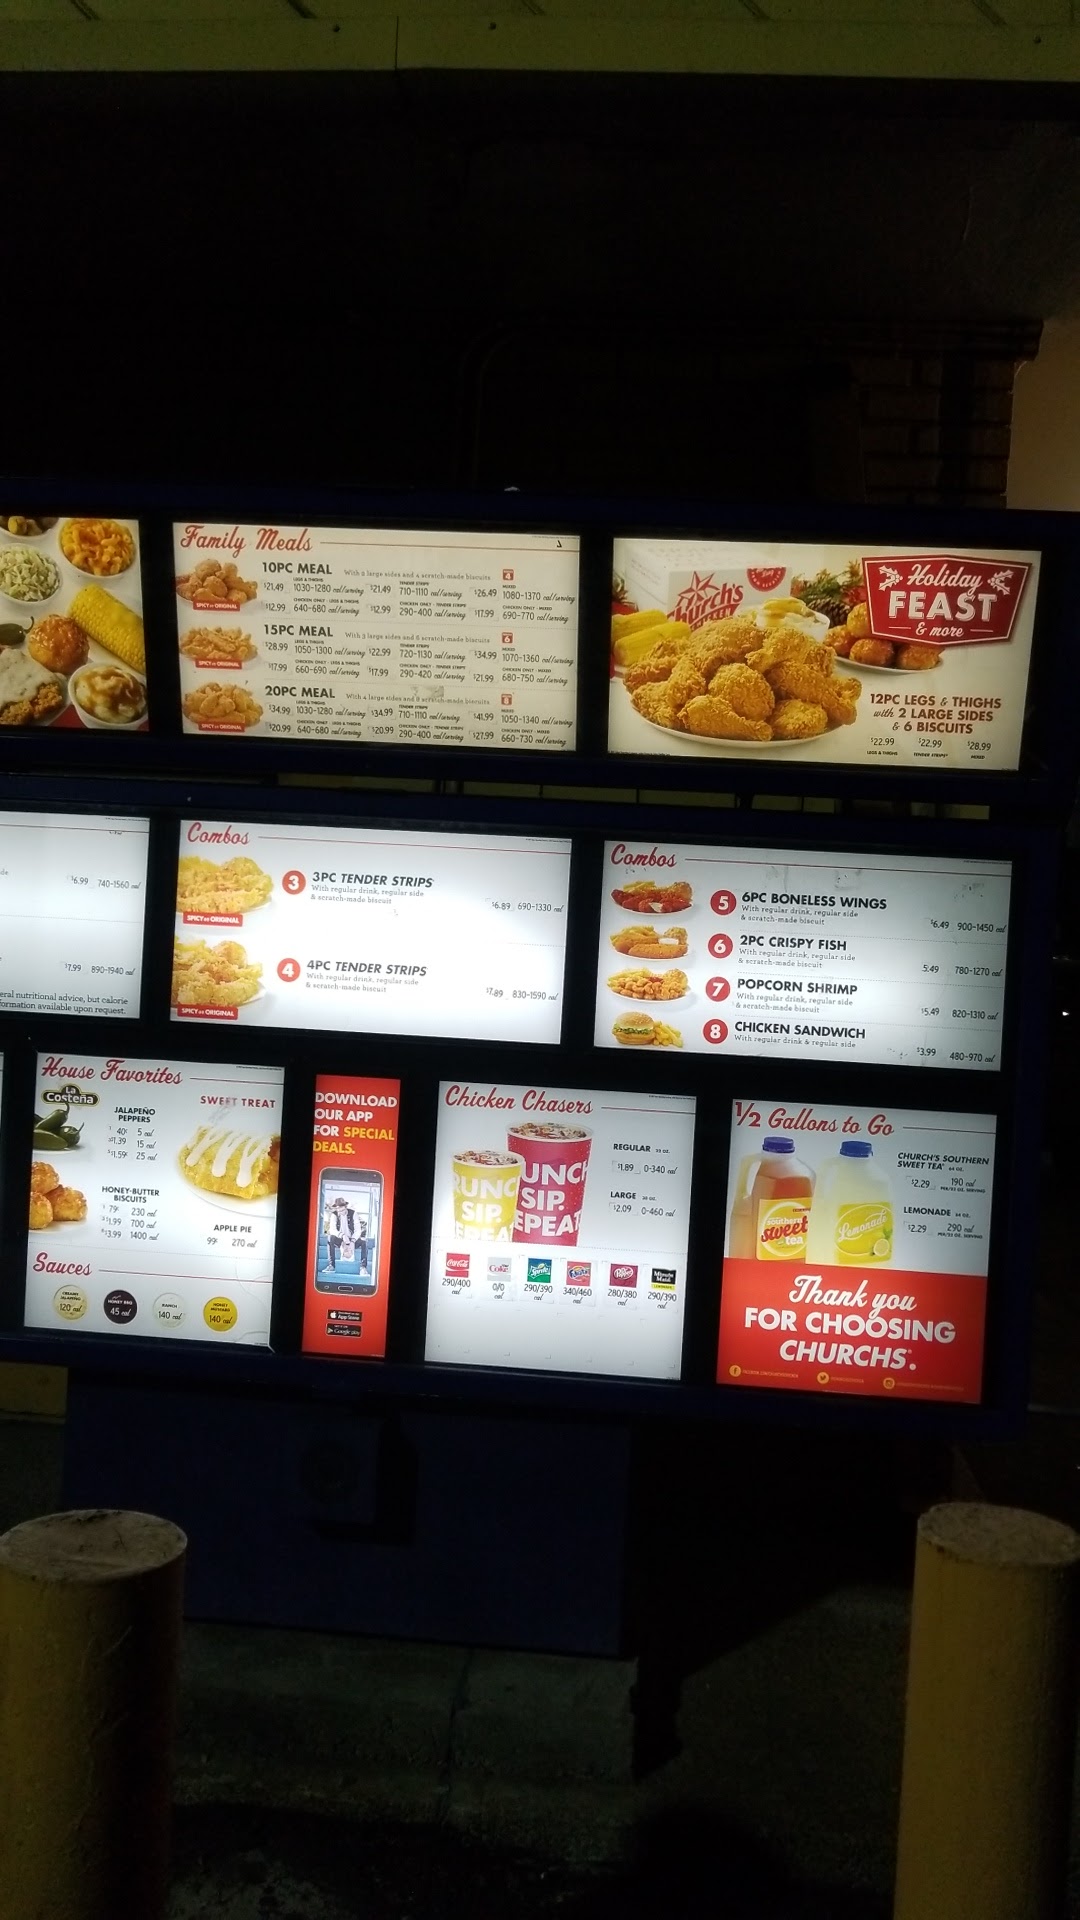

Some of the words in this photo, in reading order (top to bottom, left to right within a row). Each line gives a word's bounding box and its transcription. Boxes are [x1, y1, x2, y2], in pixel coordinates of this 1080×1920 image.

[180, 525, 246, 558] Family
[255, 528, 313, 552] Meals
[262, 562, 293, 573] 10PC
[297, 563, 332, 575] MEAL
[504, 572, 511, 580] 4
[907, 563, 983, 596] Holiday
[264, 583, 284, 592] $21.49
[294, 583, 331, 593] 1030-1280
[474, 588, 497, 597] $26.49
[502, 591, 541, 600] 1080-1370
[888, 591, 997, 622] FEAST
[264, 625, 294, 636] 15PC
[299, 626, 333, 637] MEAL
[916, 623, 927, 635] &
[929, 626, 964, 638] more
[265, 642, 289, 651] $28.99
[295, 645, 333, 655] 1050-1300
[474, 651, 497, 659] $34.99
[502, 653, 540, 663] 1070-1360
[265, 685, 297, 697] 20PC
[301, 687, 335, 698] MEAL
[870, 694, 900, 705] 12PC
[904, 695, 936, 706] LEGS
[940, 698, 949, 707] &
[952, 697, 1002, 709] THIGHS
[474, 712, 494, 721] $41.99
[501, 715, 540, 725] 1050-1340
[873, 707, 894, 718] with
[898, 709, 907, 718] 2
[911, 709, 953, 720] LARGE
[957, 711, 993, 721] SIDES
[892, 723, 900, 731] &
[903, 722, 912, 731] 6
[917, 723, 973, 734] BISCUITS
[871, 738, 895, 746] $22.99
[918, 739, 942, 748] $22.99
[968, 741, 991, 750] $28.99
[187, 822, 250, 845] Combos
[610, 843, 677, 867] Combos
[97, 879, 129, 889] 740-1560
[288, 875, 299, 890] 3
[312, 872, 336, 883] 3PC
[341, 873, 388, 886] TENDER
[392, 877, 433, 888] STRIPS
[518, 902, 552, 912] 690-1330
[718, 896, 729, 910] 5
[742, 892, 767, 903] 6PC
[771, 894, 836, 906] BONELESS
[840, 896, 888, 909] WINGS
[210, 916, 240, 924] ORIGINAL
[930, 919, 950, 929] $6.49
[957, 922, 994, 933] 900-1450
[713, 940, 725, 953] 6
[740, 935, 764, 946] 2PC
[769, 937, 814, 949] CRISPY
[818, 939, 847, 950] FISH
[282, 964, 295, 977] 4
[306, 960, 331, 971] 4PC
[335, 962, 382, 974] TENDER
[385, 965, 427, 976] STRIPS
[955, 966, 990, 976] 780-1270
[712, 983, 725, 997] 7
[737, 979, 803, 992] POPCORN
[807, 982, 858, 995] SHRIMP
[16, 992, 57, 1000] nutritional
[58, 995, 86, 1003] advice,
[87, 995, 100, 1003] but
[101, 996, 128, 1004] calorie
[37, 1002, 72, 1010] available
[709, 1024, 721, 1038] 8
[734, 1021, 790, 1034] CHICKEN
[794, 1025, 866, 1039] SANDWICH
[917, 1047, 936, 1056] $3.99
[950, 1052, 983, 1062] 480-970
[41, 1056, 95, 1080] House
[100, 1059, 183, 1085] Favorites
[46, 1091, 94, 1104] Costeña
[200, 1096, 237, 1106] SWEET
[242, 1098, 276, 1108] TREAT
[315, 1091, 397, 1107] DOWNLOAD
[445, 1084, 516, 1110] Chicken
[522, 1089, 593, 1114] Chasers
[114, 1107, 155, 1115] JALAPEÑO
[314, 1109, 344, 1121] OUR
[346, 1110, 373, 1122] APP
[118, 1115, 151, 1123] PEPPERS
[767, 1107, 839, 1133] Gallons
[841, 1115, 862, 1133] to
[868, 1114, 895, 1136] Go
[313, 1125, 339, 1137] FOR
[343, 1127, 395, 1141] SPECIAL
[313, 1141, 356, 1155] DEALS.
[613, 1143, 651, 1152] REGULAR
[136, 1152, 145, 1160] 25
[898, 1153, 940, 1161] CHURCH'S
[943, 1155, 989, 1164] SOUTHERN
[617, 1163, 634, 1173] $1.89
[643, 1164, 666, 1174] 0-340
[897, 1161, 925, 1169] SWEET
[912, 1179, 930, 1188] $2.29
[951, 1178, 964, 1186] 190
[102, 1186, 160, 1196] HONEY-BUTTER
[610, 1191, 637, 1200] LARGE
[114, 1195, 147, 1203] BISCUITS
[521, 1188, 565, 1211] SIP.
[462, 1201, 502, 1223] SIP.
[904, 1207, 951, 1216] LEMONADE
[767, 1217, 803, 1225] southern
[838, 1209, 887, 1242] Lemonade
[761, 1215, 808, 1242] sweet
[130, 1231, 147, 1240] 1400
[785, 1235, 803, 1245] tea
[232, 1239, 245, 1247] 270
[33, 1252, 92, 1276] Sauces
[442, 1278, 471, 1288] 290/400
[524, 1283, 553, 1294] 290/390
[789, 1275, 868, 1307] Thank
[870, 1292, 917, 1319] you
[158, 1311, 171, 1319] 140
[745, 1307, 797, 1332] FOR
[805, 1311, 956, 1343] CHOOSING
